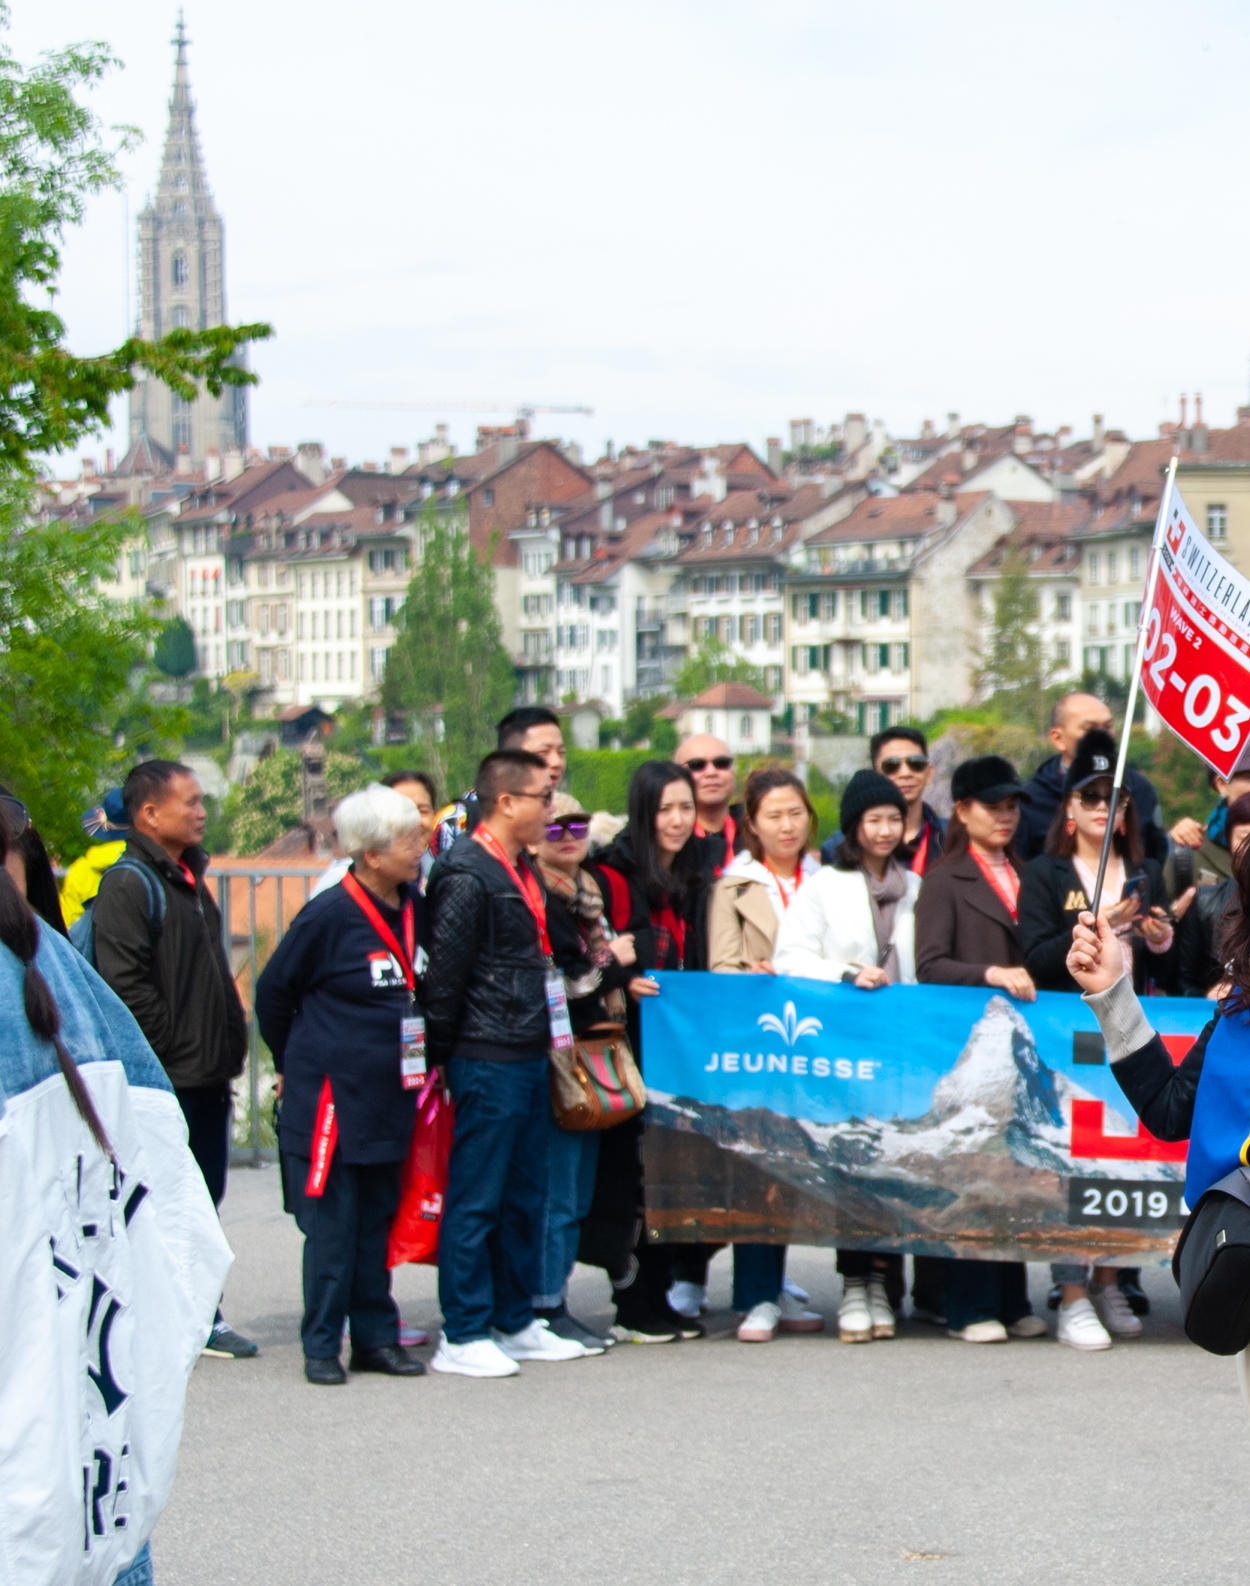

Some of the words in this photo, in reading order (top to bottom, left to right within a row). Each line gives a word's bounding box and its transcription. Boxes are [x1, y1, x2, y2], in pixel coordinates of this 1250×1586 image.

[1169, 606, 1195, 642] WAVE
[1192, 636, 1203, 650] 2
[367, 945, 430, 980] FIA
[704, 1052, 876, 1080] JEUNESSE
[1081, 1188, 1169, 1218] 2019
